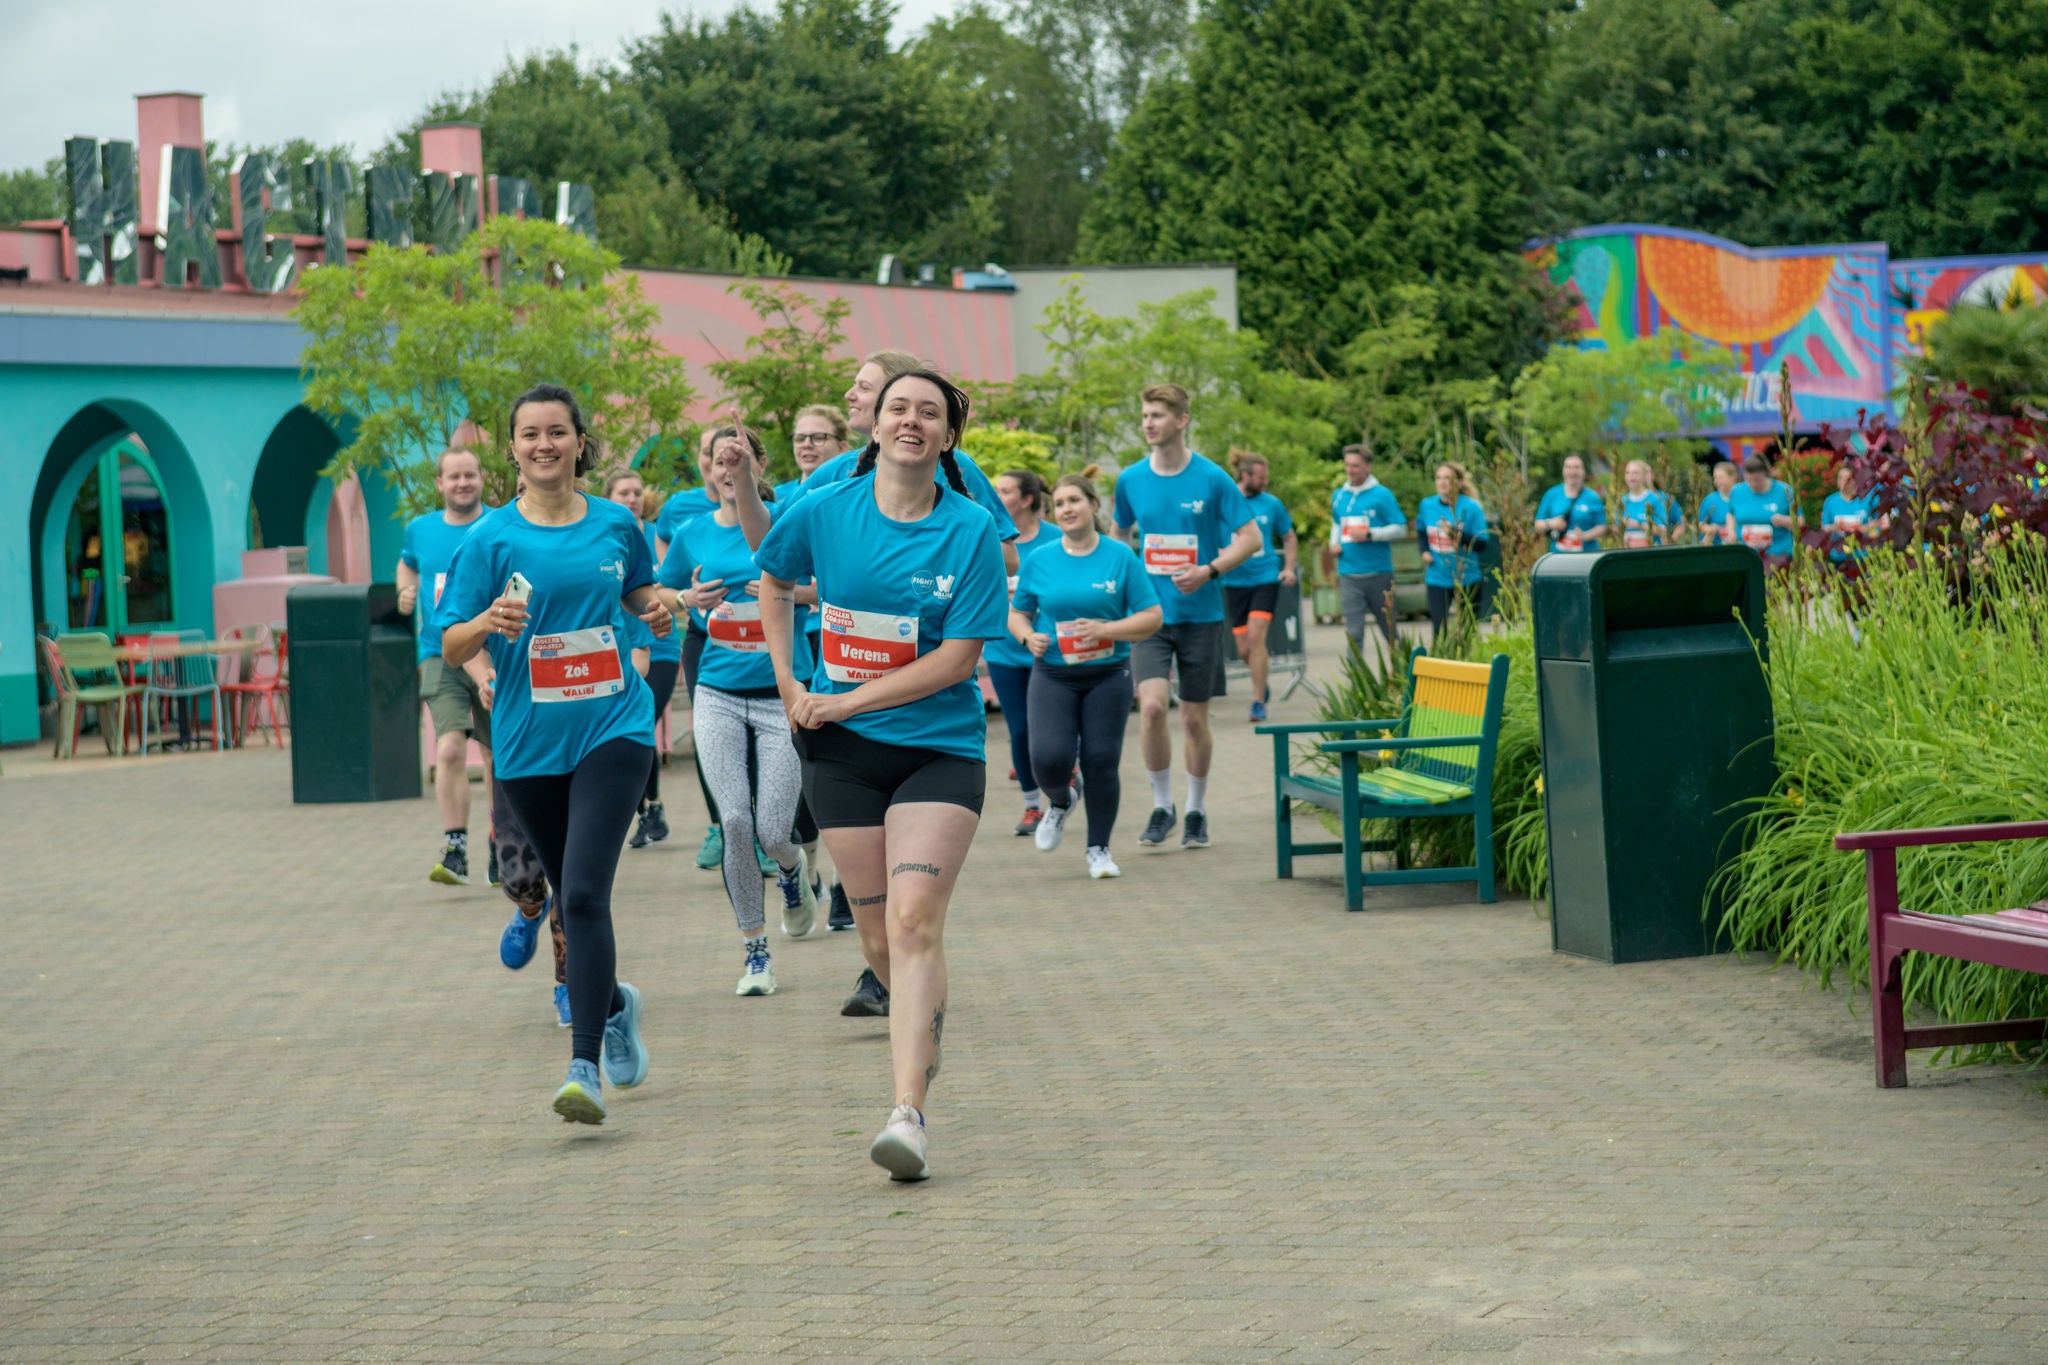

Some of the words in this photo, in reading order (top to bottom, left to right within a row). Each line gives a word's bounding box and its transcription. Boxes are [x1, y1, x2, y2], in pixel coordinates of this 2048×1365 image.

[912, 577, 933, 586] FIGHT
[826, 614, 853, 627] COASTER
[840, 643, 891, 663] Verena
[564, 663, 589, 679] Zoë
